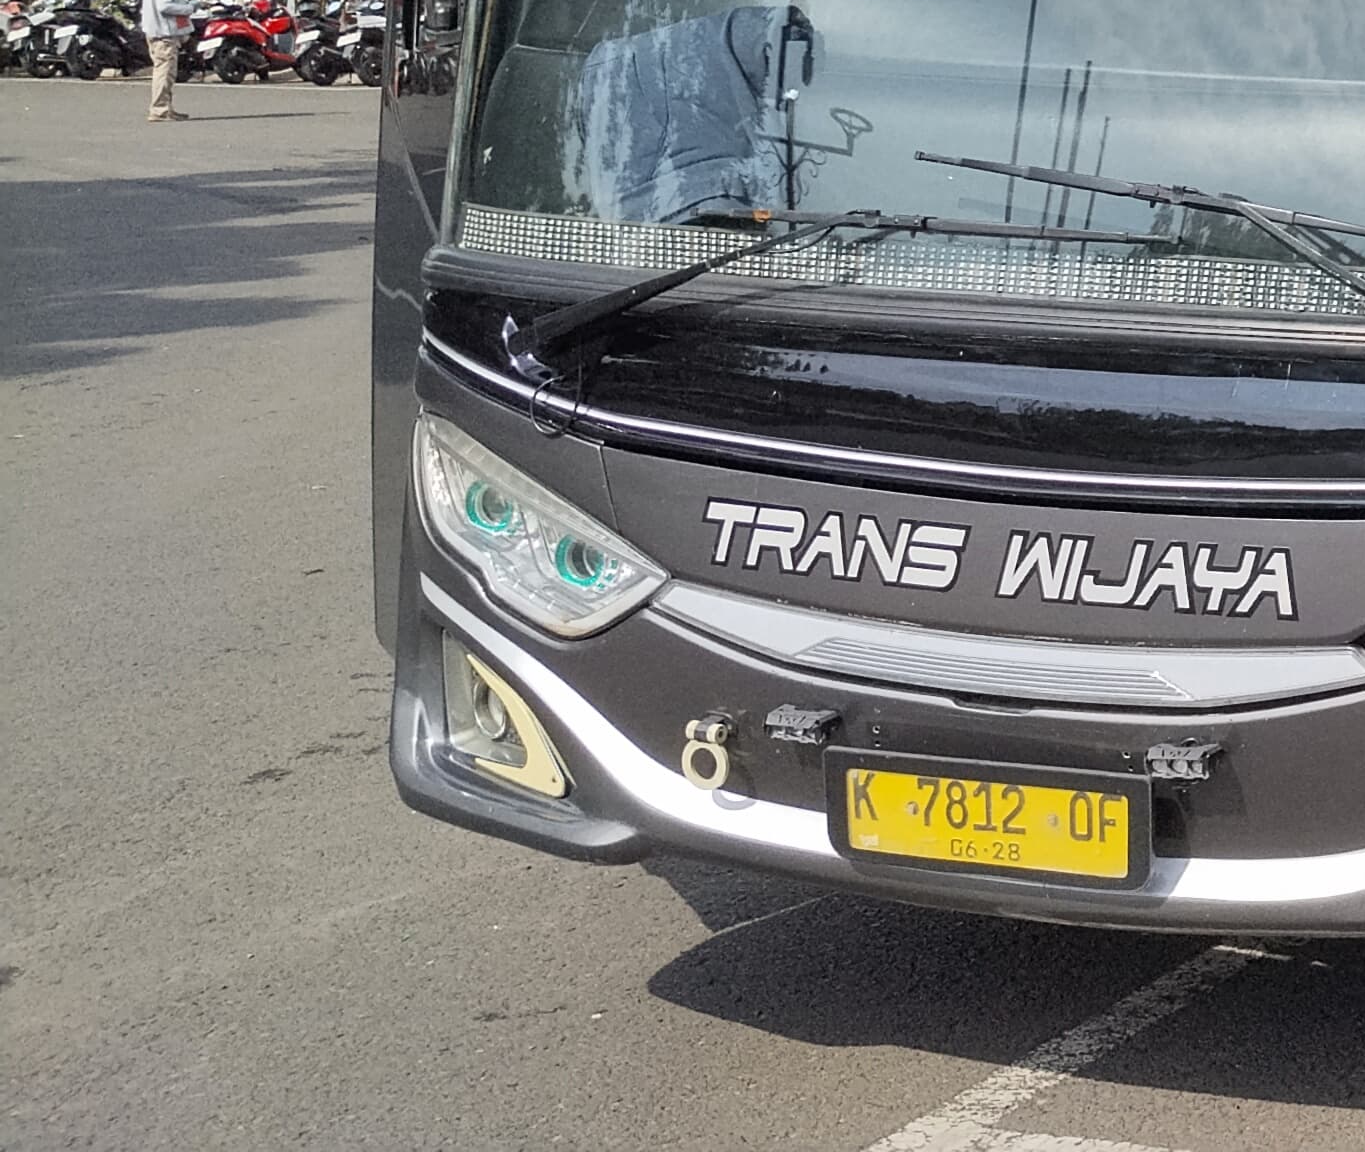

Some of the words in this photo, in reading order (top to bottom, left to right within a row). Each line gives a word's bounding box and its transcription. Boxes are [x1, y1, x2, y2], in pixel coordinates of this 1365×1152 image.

[702, 496, 972, 592] TRANS
[995, 529, 1299, 621] WIJAYA
[853, 772, 878, 821] K
[917, 777, 1027, 836] 7812
